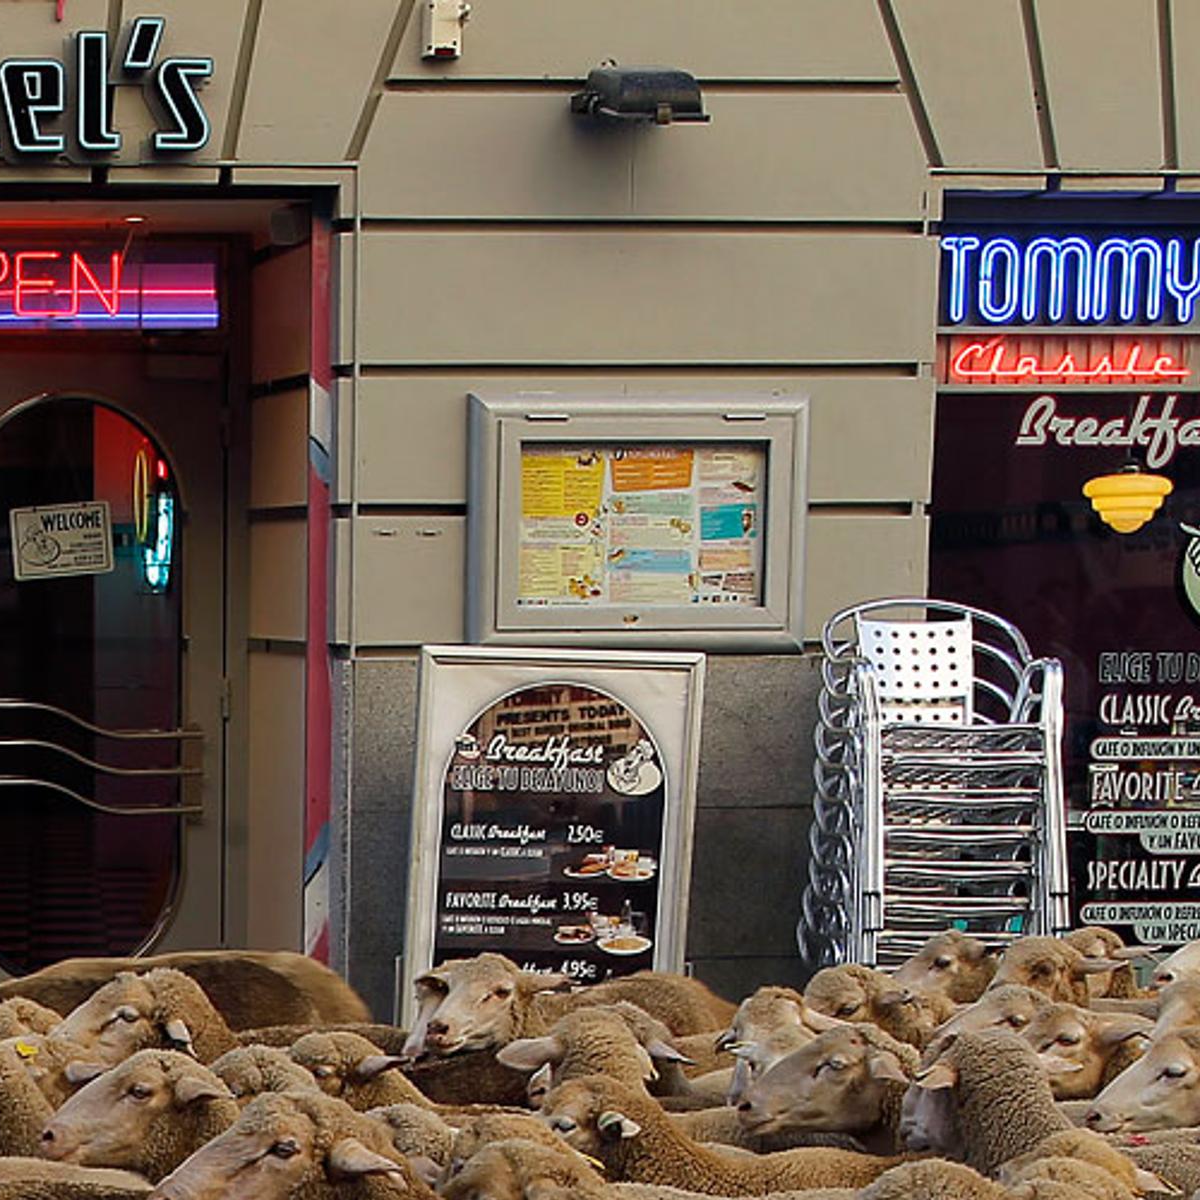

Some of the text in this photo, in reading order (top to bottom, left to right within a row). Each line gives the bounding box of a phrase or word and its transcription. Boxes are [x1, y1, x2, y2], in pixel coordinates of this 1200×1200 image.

[940, 237, 1200, 323] TOMMY
[954, 342, 1191, 376] Classic
[40, 511, 102, 532] WELCOME
[1099, 652, 1153, 682] ELIGE
[1156, 652, 1184, 682] TU
[496, 707, 570, 726] PRESENTS
[1100, 694, 1172, 725] CLASSIC
[485, 734, 603, 773] Breakfast
[1091, 771, 1186, 801] FAVORITE
[1087, 860, 1187, 890] SPECIALTY
